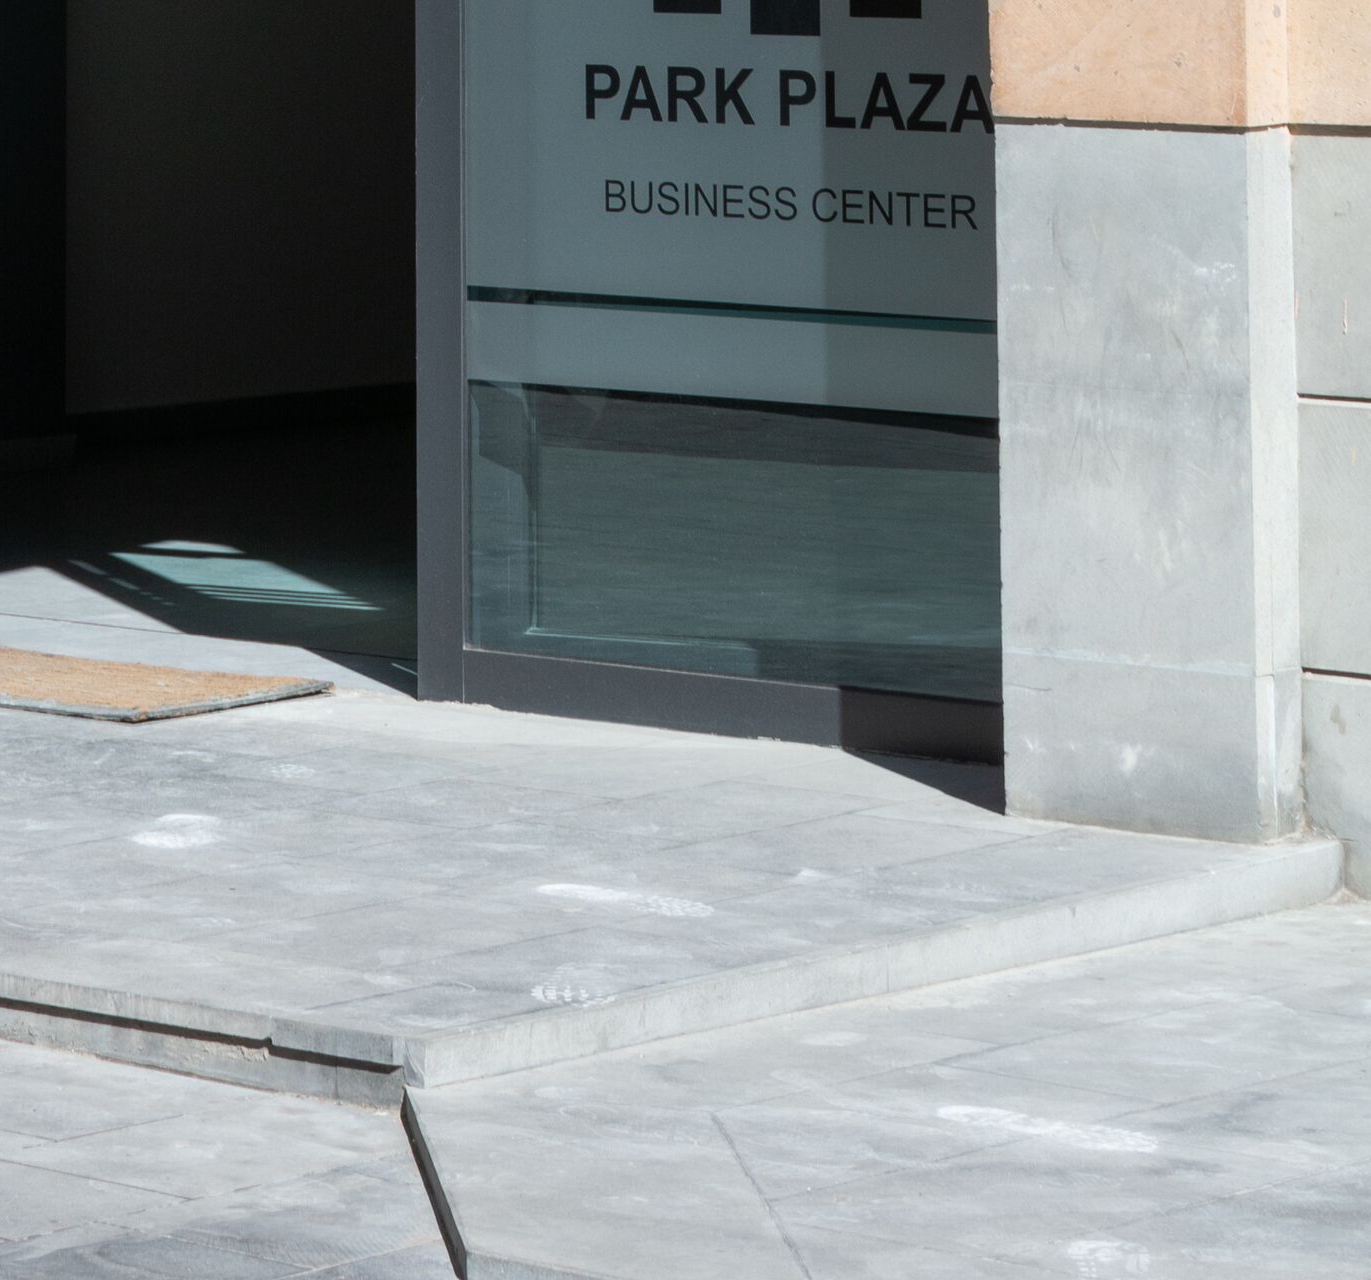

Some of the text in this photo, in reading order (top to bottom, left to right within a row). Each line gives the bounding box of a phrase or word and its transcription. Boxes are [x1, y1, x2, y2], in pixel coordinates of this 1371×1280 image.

[584, 63, 996, 136] PARK PLAZA
[604, 178, 980, 232] BUSINESS CENTER
